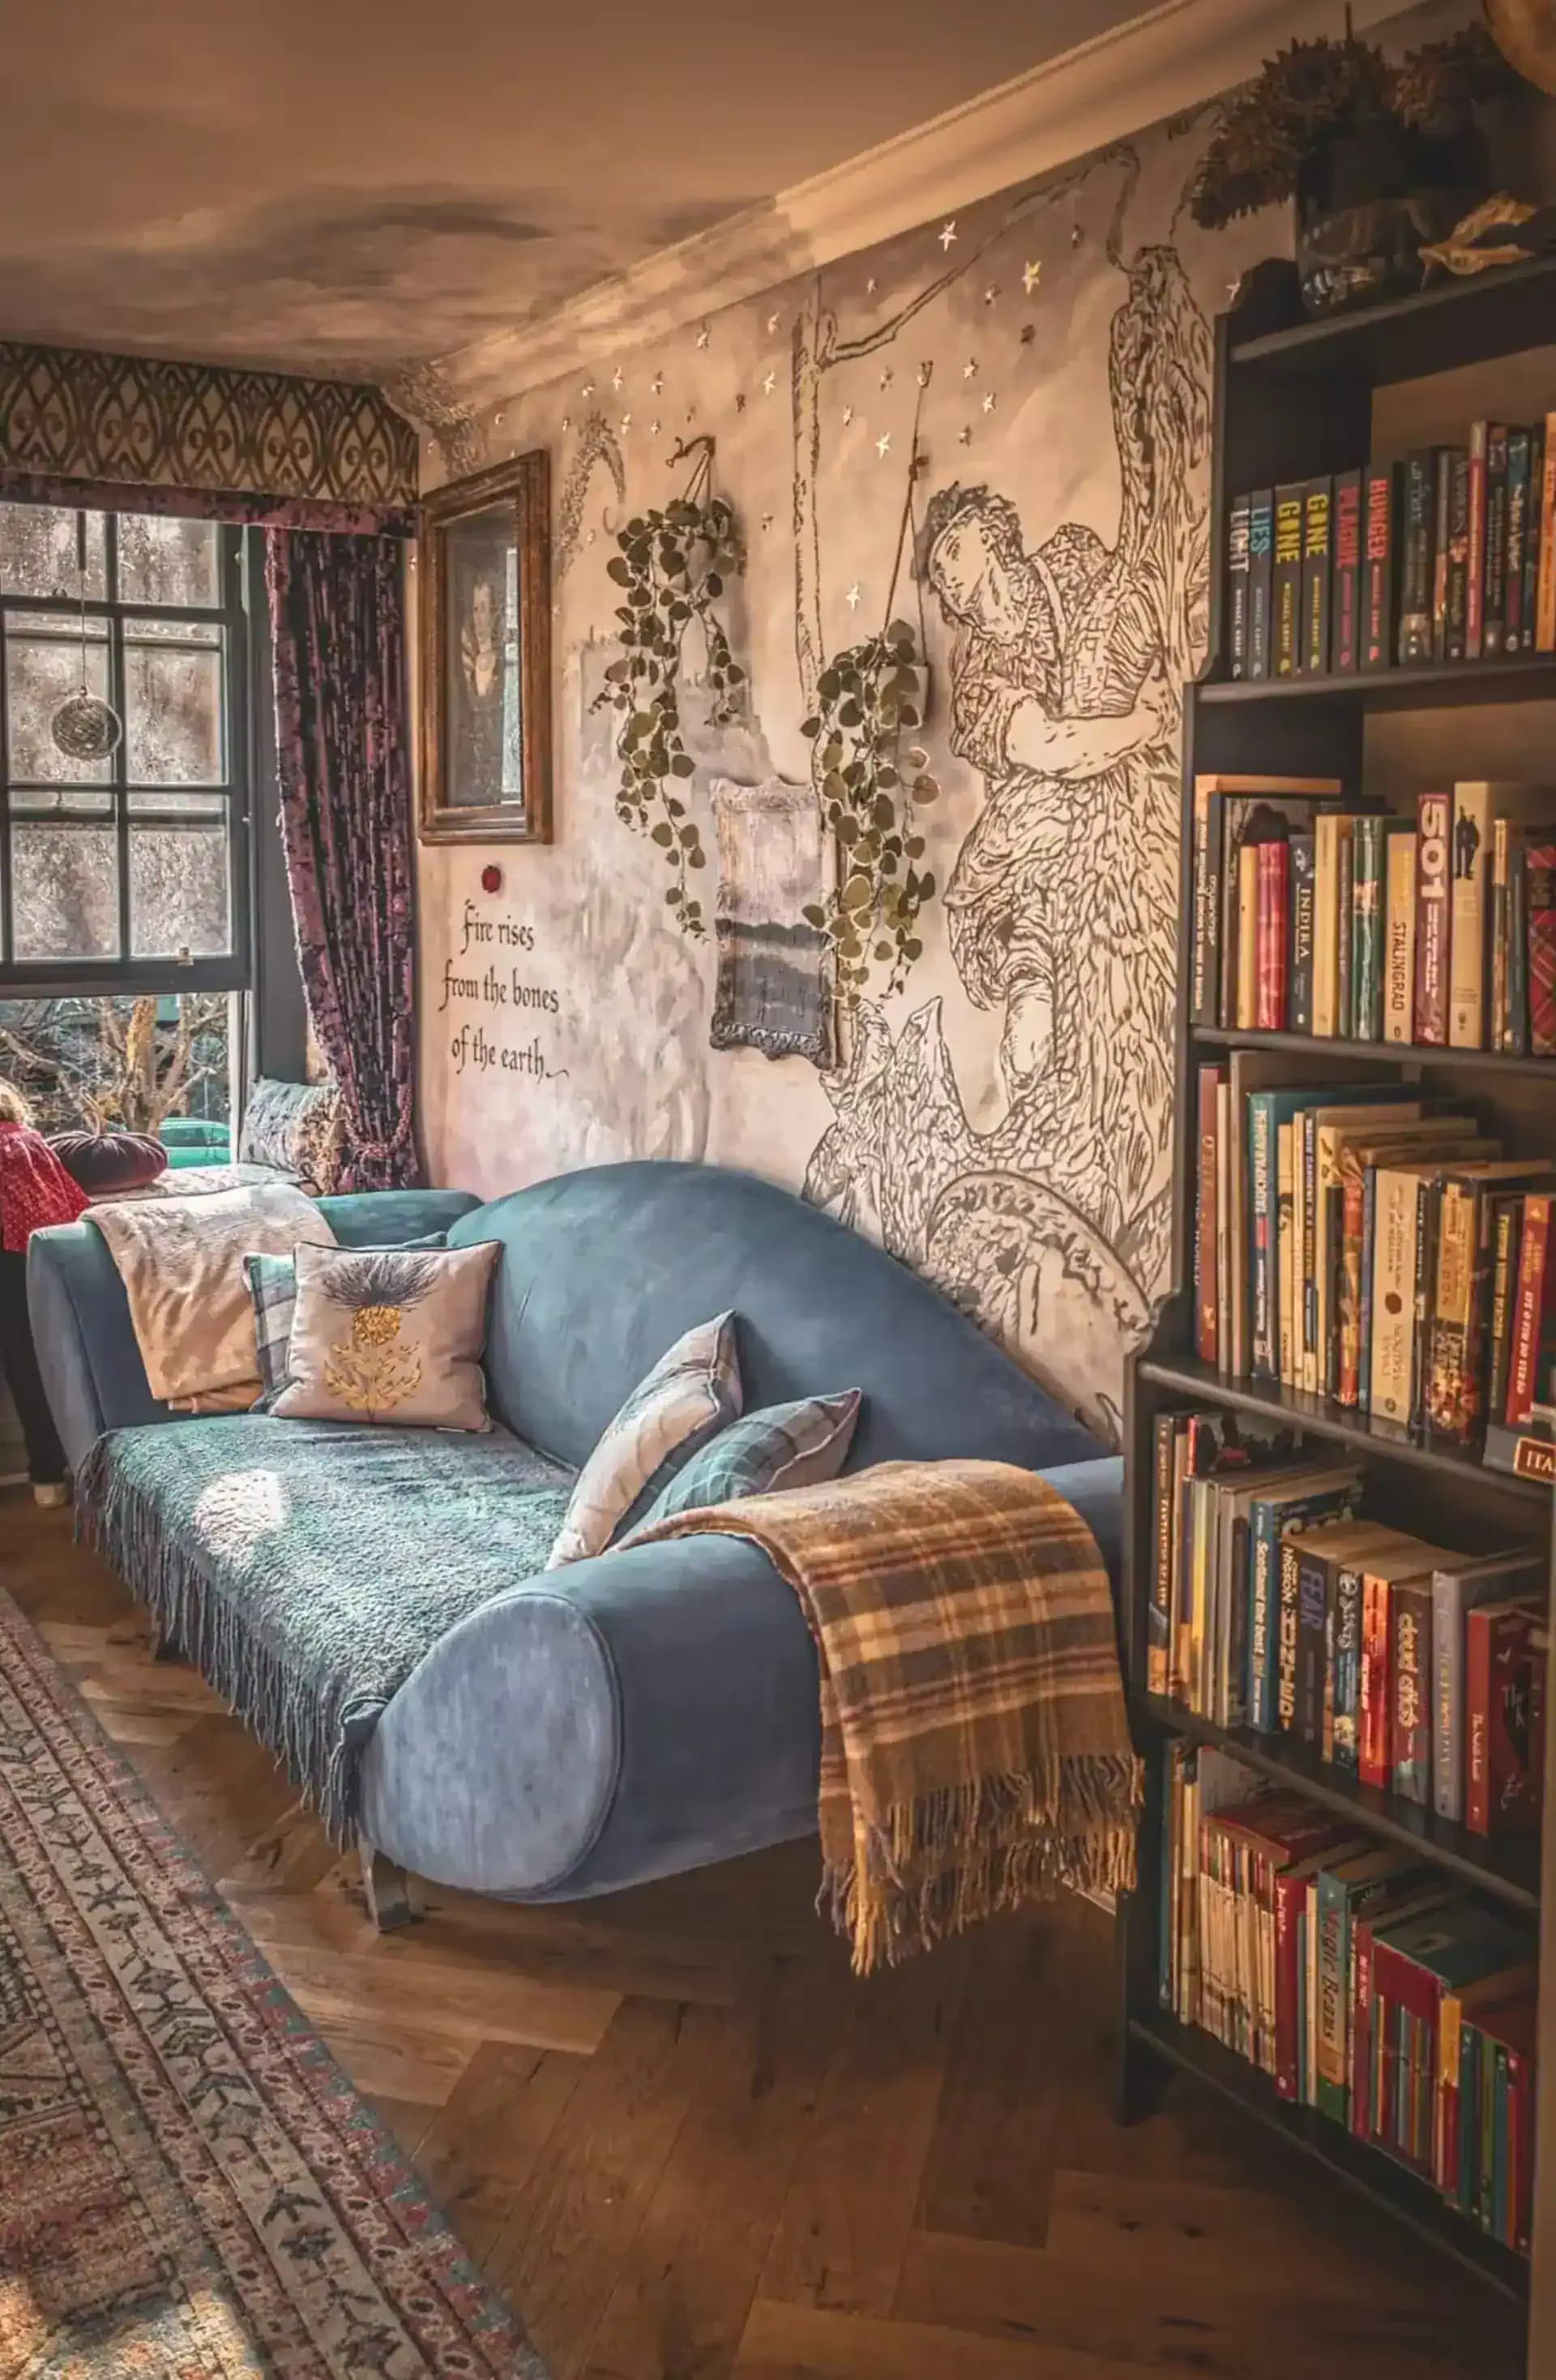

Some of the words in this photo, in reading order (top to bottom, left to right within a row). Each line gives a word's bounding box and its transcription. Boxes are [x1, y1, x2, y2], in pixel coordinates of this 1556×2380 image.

[1229, 507, 1250, 573] LIGHT
[1250, 506, 1271, 555] LIES
[1276, 501, 1301, 565] GONE
[1306, 493, 1328, 559] GONE
[1367, 479, 1388, 560] HUNGER
[1421, 801, 1449, 898] 501
[460, 899, 494, 955] Fire
[498, 915, 535, 951] rises
[1300, 888, 1311, 958] INDIRA
[438, 959, 479, 1012] from
[484, 966, 507, 1011] the
[512, 968, 559, 1013] bones
[1391, 921, 1407, 1011] STALINGRAD
[451, 1024, 470, 1075] of
[473, 1027, 496, 1073] the
[501, 1037, 545, 1083] earth
[1526, 1451, 1556, 1473] ITA
[1255, 1540, 1269, 1600] Scotland
[1301, 1566, 1324, 1630] FEAR
[1254, 1624, 1266, 1654] best
[1255, 1601, 1266, 1623] the
[1321, 1906, 1342, 1972] Magic
[1322, 1975, 1340, 2042] Beans
